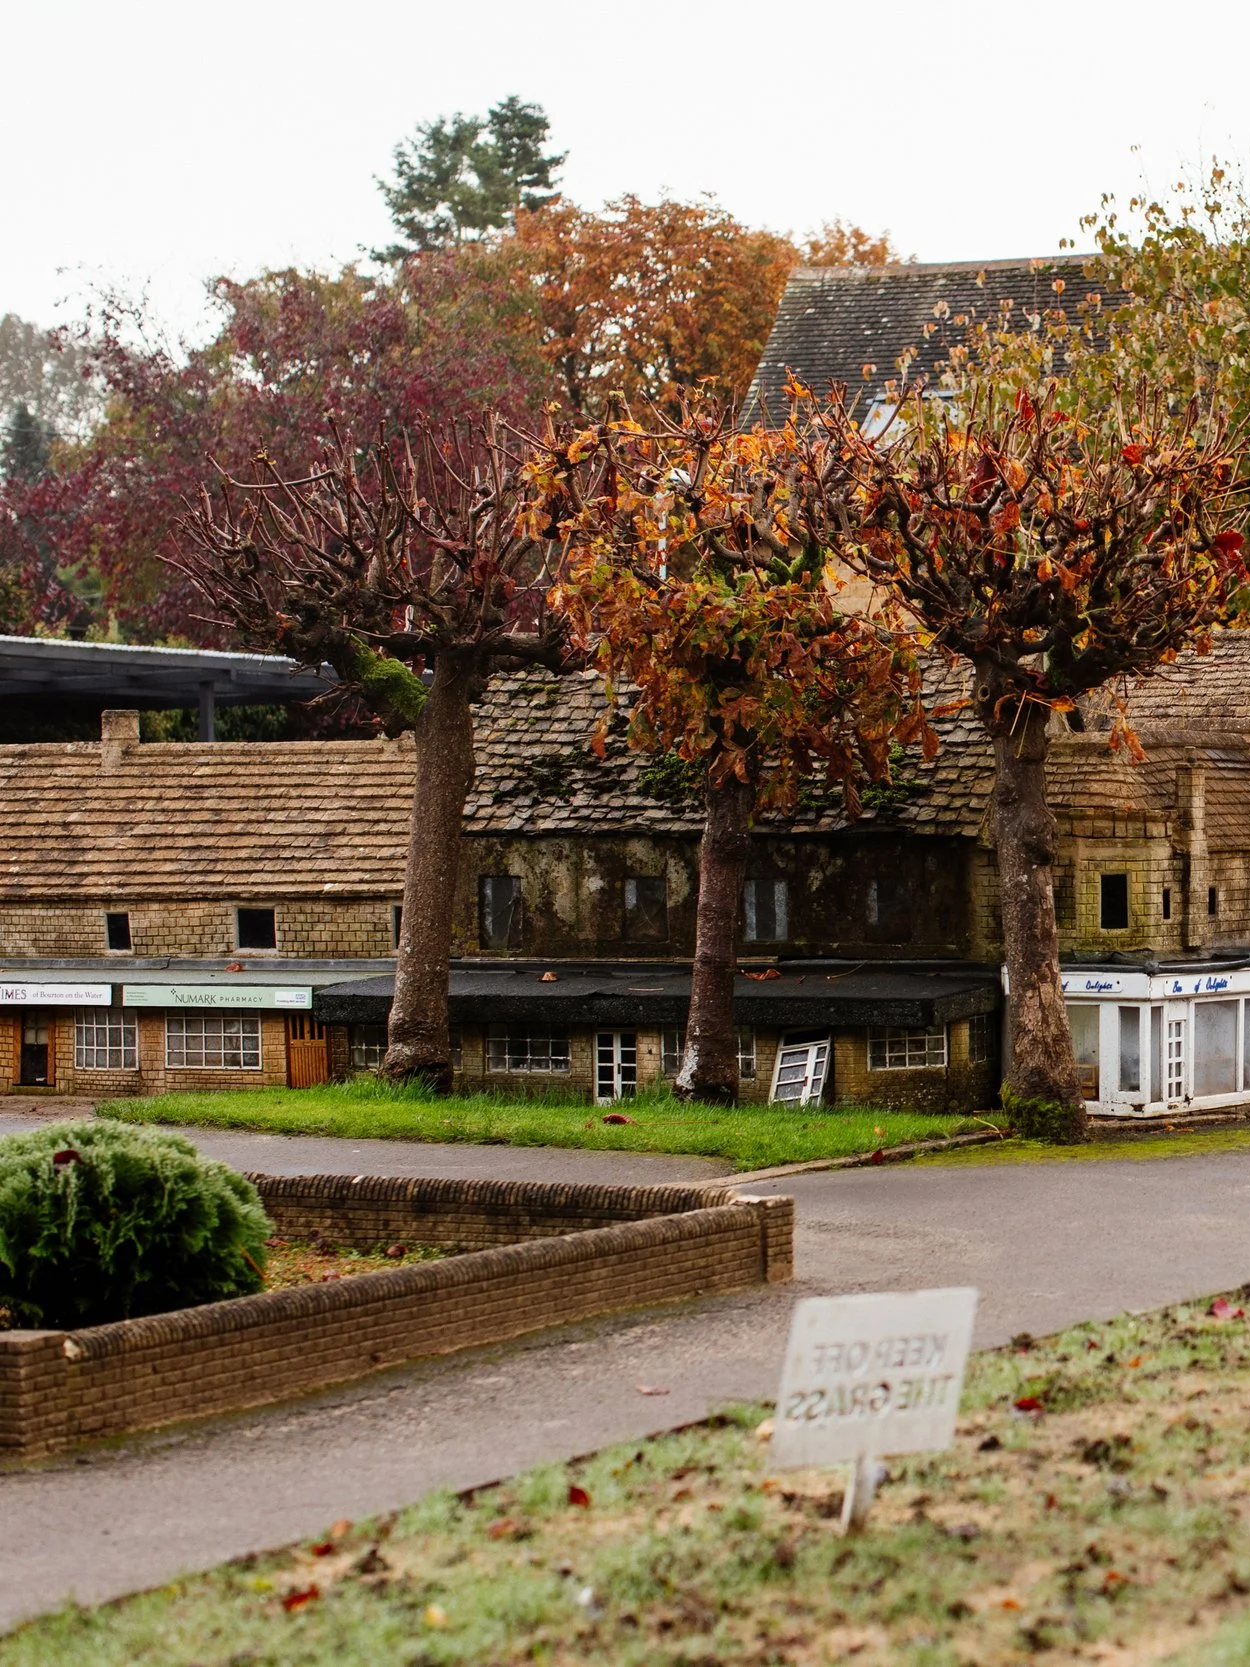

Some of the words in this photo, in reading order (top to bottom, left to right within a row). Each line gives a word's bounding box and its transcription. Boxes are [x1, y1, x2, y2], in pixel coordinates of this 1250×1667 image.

[0, 986, 27, 1000] IMES
[40, 991, 64, 999] Bourton
[74, 991, 83, 999] the
[84, 991, 103, 999] Water
[175, 993, 217, 1005] NUMARK
